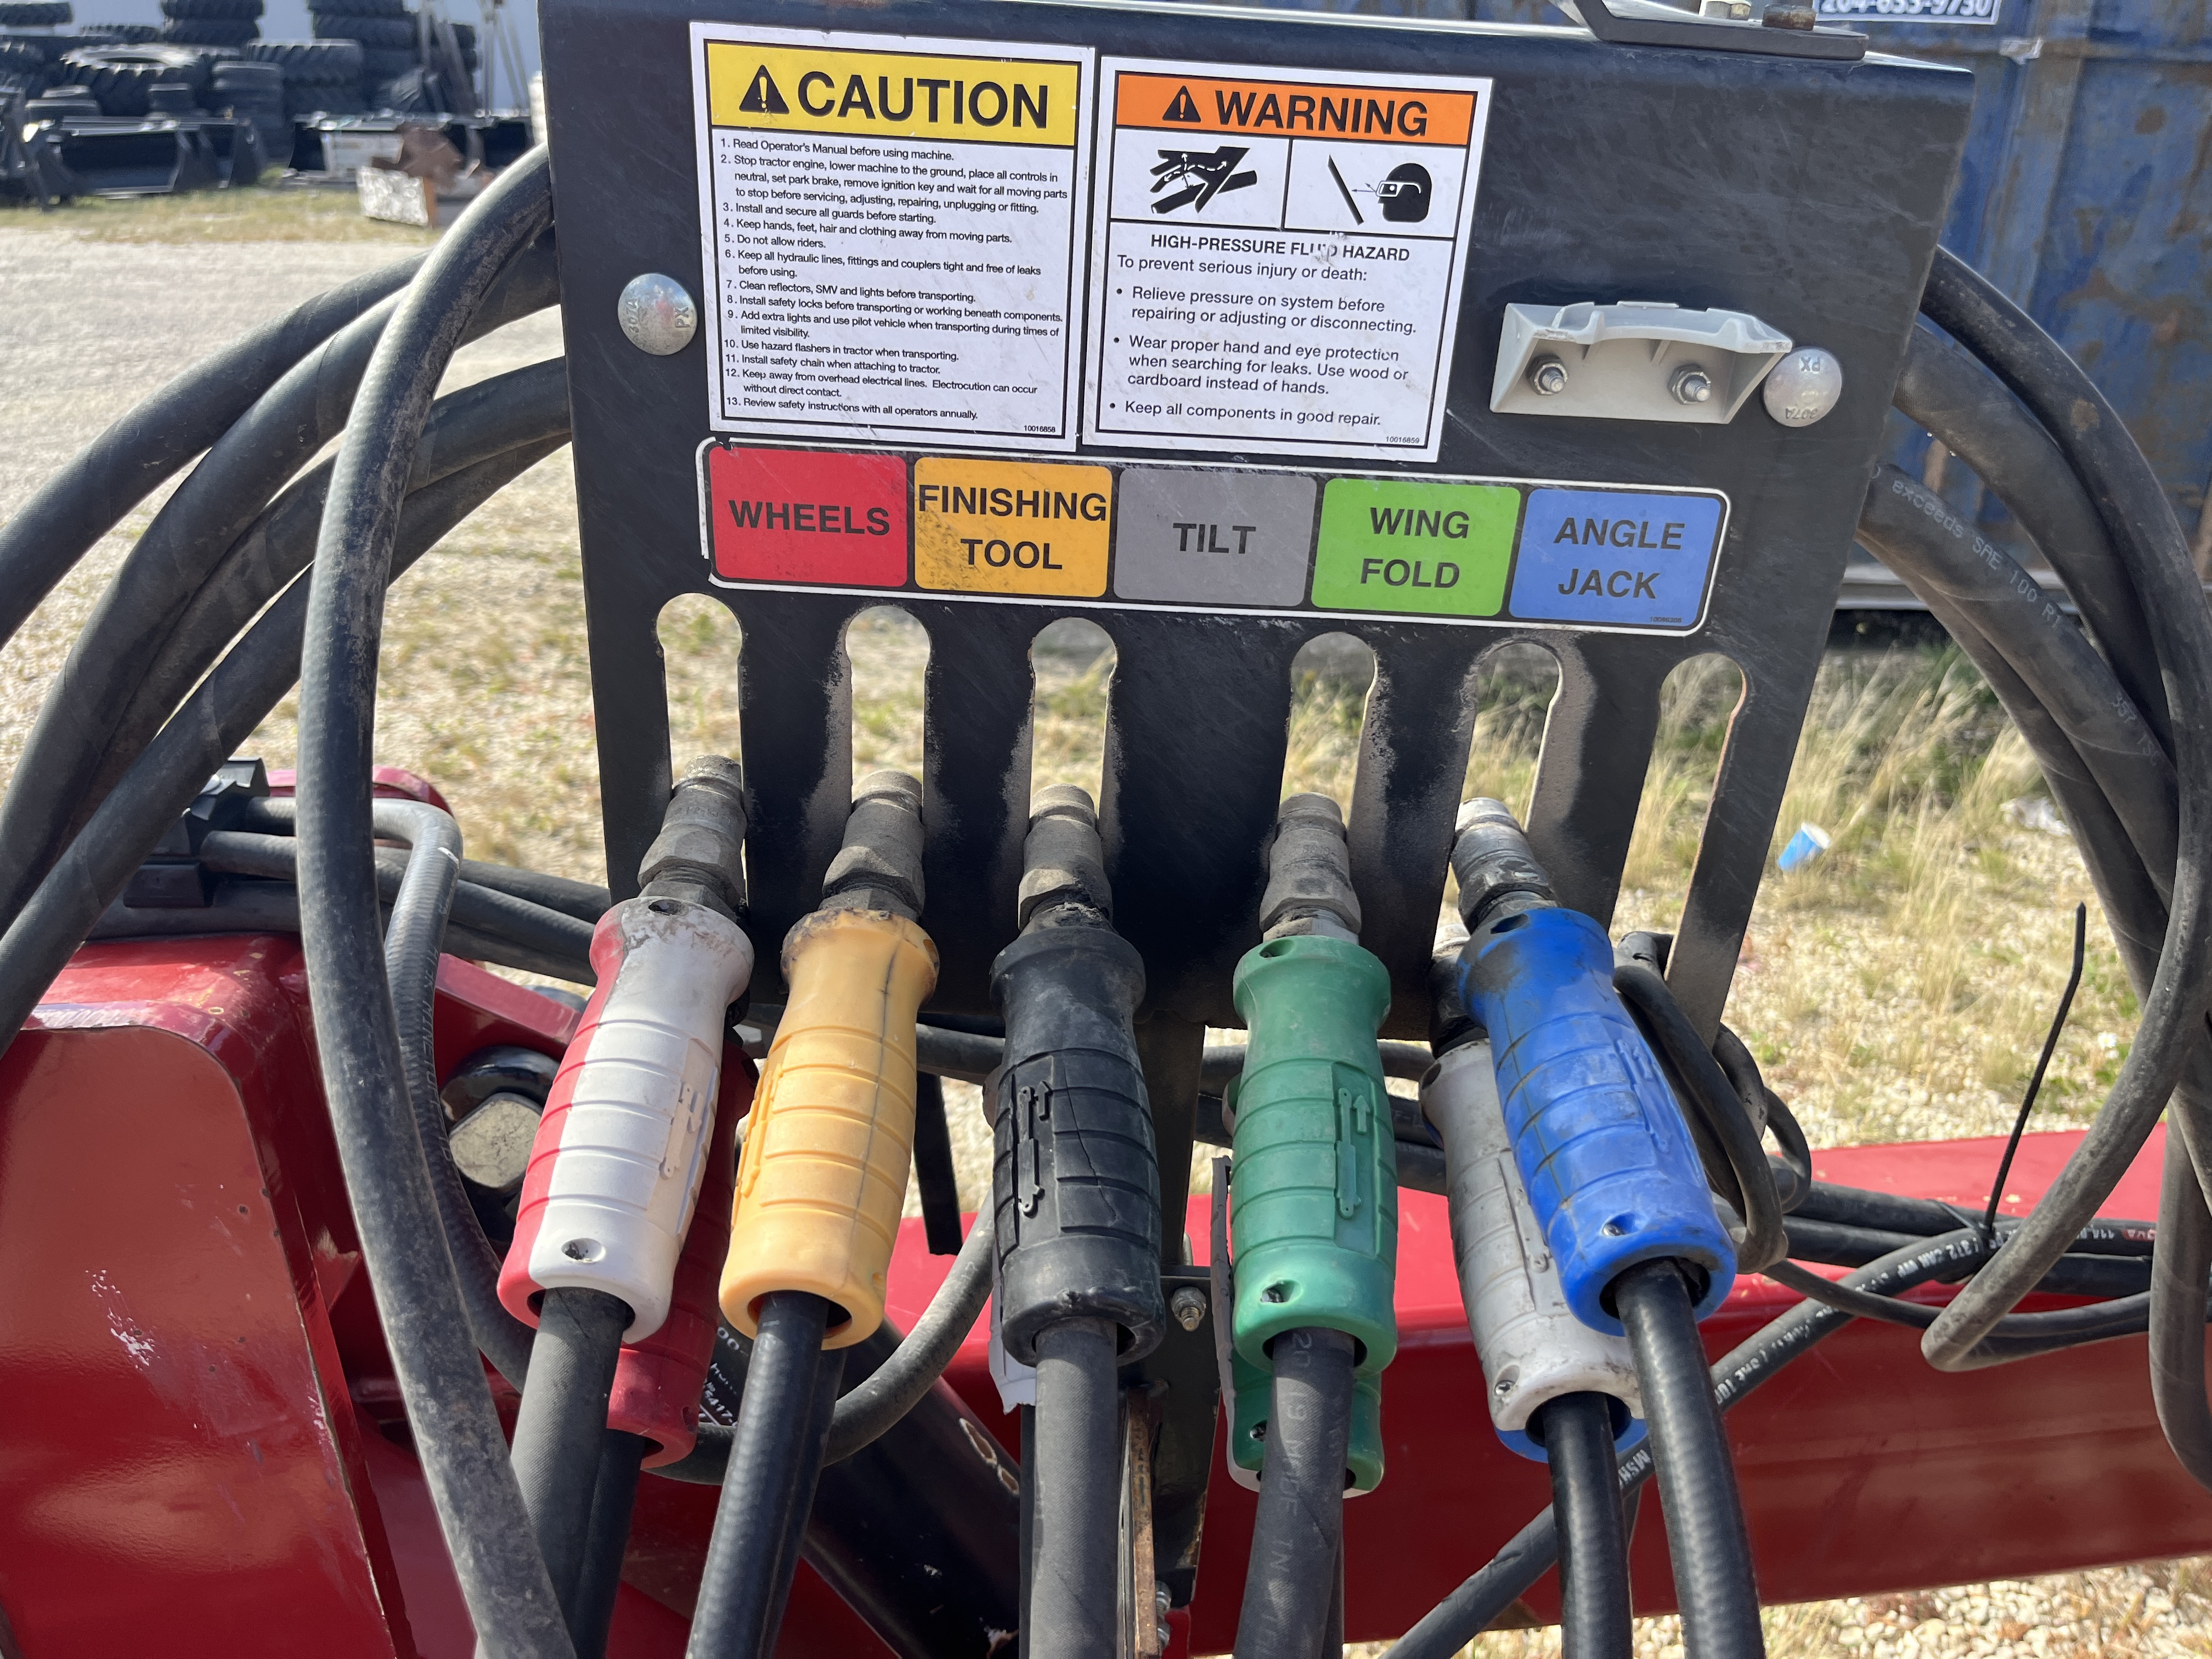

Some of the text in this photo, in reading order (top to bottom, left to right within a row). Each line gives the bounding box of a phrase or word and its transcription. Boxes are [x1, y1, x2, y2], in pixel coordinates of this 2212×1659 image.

[798, 71, 1048, 128] CAUTION
[1215, 90, 1427, 136] WARNING
[720, 138, 954, 160] 1. Read Operator's Manual before using machine.
[720, 154, 1058, 182] 2. Stop tractor engine, lower machine to the ground, place all controls in
[723, 202, 936, 225] 3. Install and secure all guards before starting.
[724, 218, 1012, 244] 4. Keep hands, feet, hair and clothing away from moving parts.
[1151, 234, 1286, 255] HIGH-PRESSURE
[1342, 245, 1409, 261] HAZARD
[1117, 254, 1367, 281] To prevent serious injury or death:
[726, 279, 976, 304] 7. Clean reflectors, SMV and lights before transporting.
[1132, 286, 1385, 312] Relieve pressure on system before
[1132, 307, 1416, 336] repairing or adjusting or disconnecting.
[724, 339, 959, 362] 10. Use hazard flashers in tractor when transporting.
[1129, 335, 1167, 349] Wear
[1170, 340, 1220, 353] proper
[1223, 340, 1259, 354] hand
[1263, 343, 1291, 356] and
[1295, 347, 1321, 359] eye
[725, 353, 940, 374] 11. Install safety chain when attaching to tractor.
[1129, 354, 1409, 380] when searching for leaks. Use wood or
[1127, 373, 1329, 394] cardboard instead of hands.
[726, 397, 978, 421] 13. Review safety instructions with all operators annually.
[1125, 400, 1380, 427] Keep all components in good repair.
[1024, 425, 1056, 433] 10016858
[919, 484, 1107, 521] FINISHING
[729, 500, 889, 537] WHEELS
[1370, 507, 1469, 539] WING
[1172, 523, 1256, 554] TILT
[1553, 517, 1685, 550] ANGLE
[1891, 479, 1965, 539] exceeds
[1972, 535, 2004, 571] SAE
[2008, 569, 2039, 603] 100
[960, 538, 1063, 569] TOOL
[1361, 558, 1460, 588] FOLD
[1558, 568, 1660, 599] JACK
